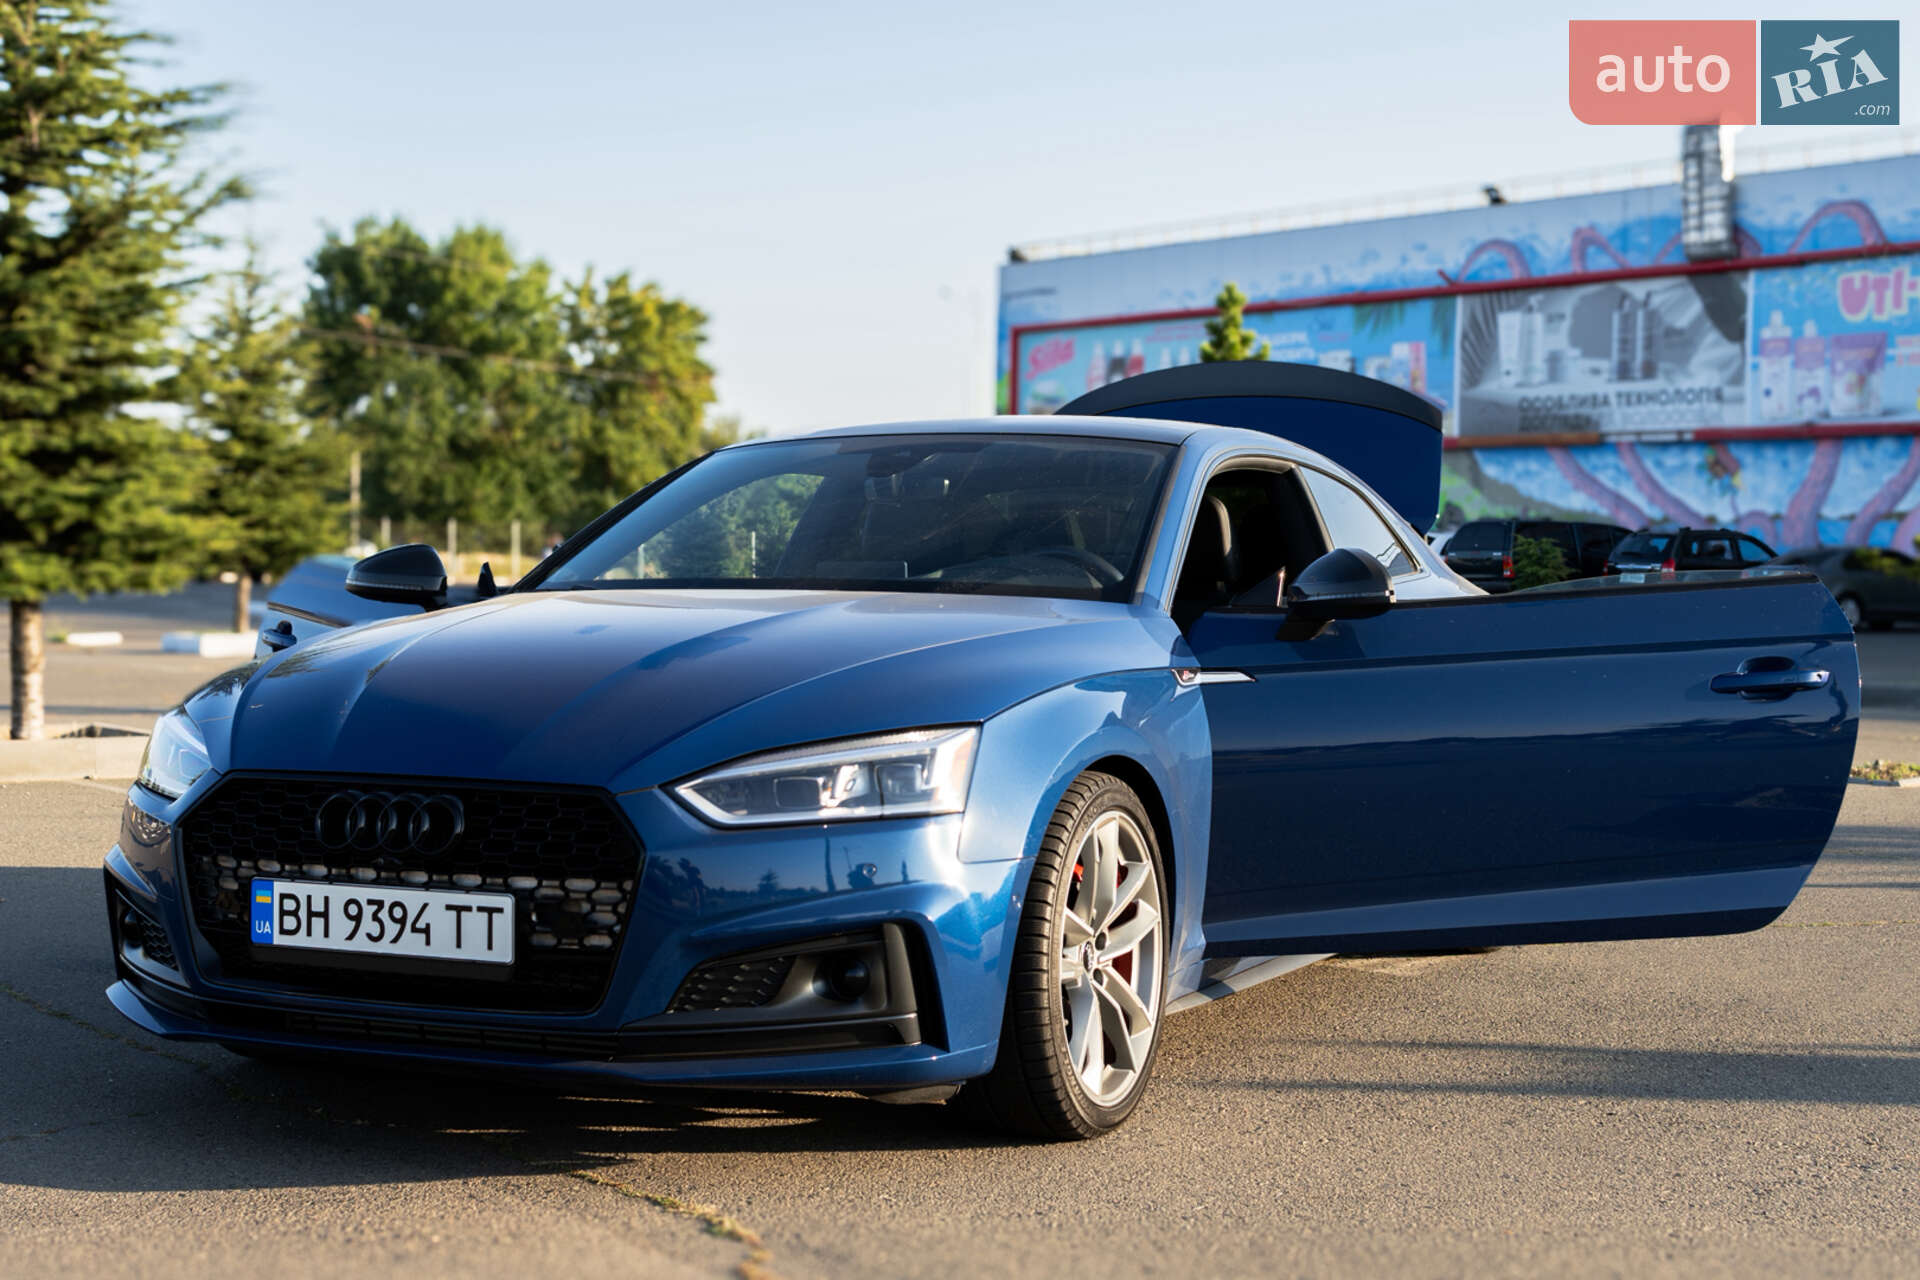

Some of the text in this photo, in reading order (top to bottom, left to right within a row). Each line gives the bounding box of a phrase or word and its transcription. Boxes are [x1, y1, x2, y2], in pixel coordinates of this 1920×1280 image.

[255, 920, 271, 934] UA
[279, 893, 504, 951] BH 9394 TT
